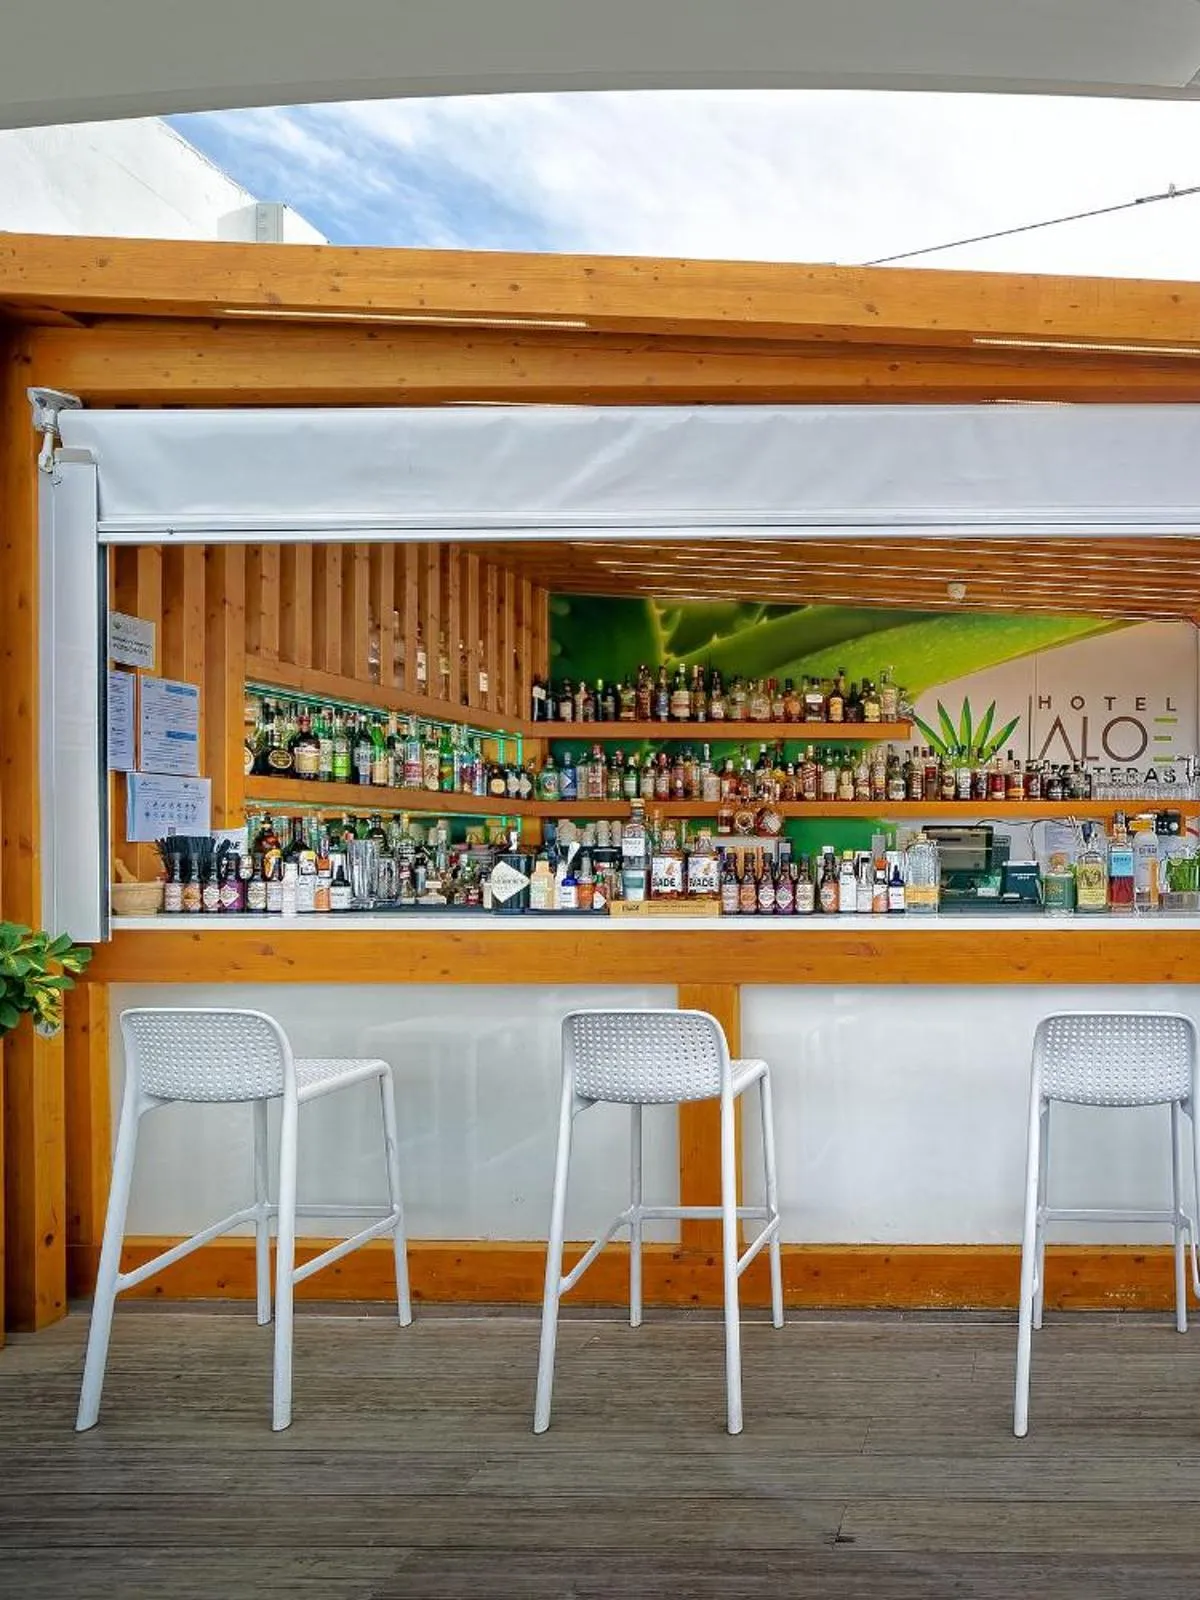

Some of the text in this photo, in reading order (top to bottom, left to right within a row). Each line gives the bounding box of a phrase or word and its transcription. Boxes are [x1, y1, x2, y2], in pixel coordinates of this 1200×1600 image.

[1038, 695, 1177, 711] HOTEL
[1038, 715, 1178, 763] ALOE
[1092, 767, 1177, 783] TERAS
